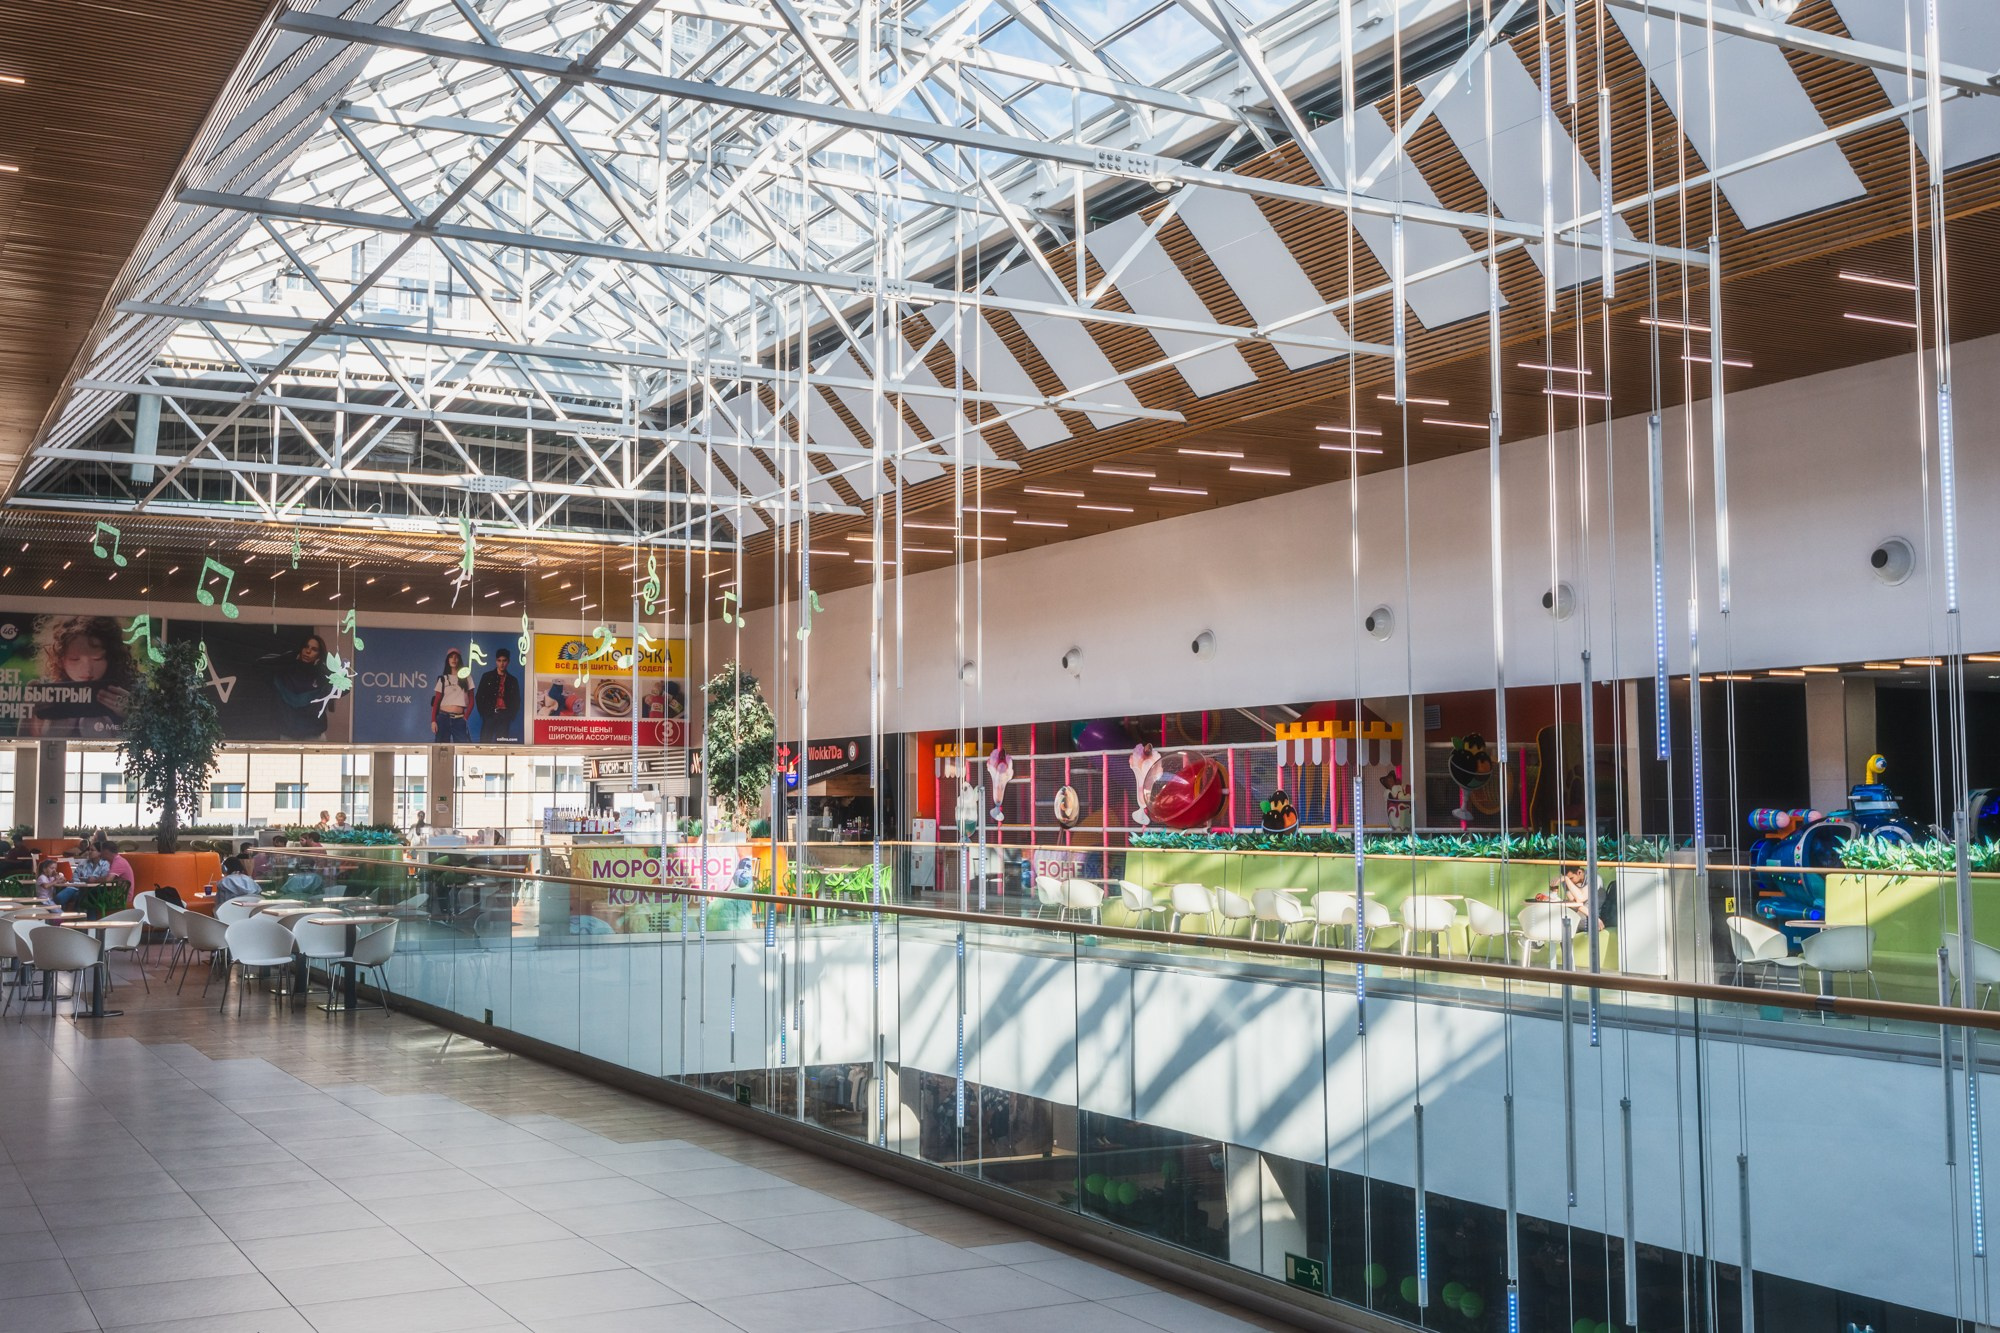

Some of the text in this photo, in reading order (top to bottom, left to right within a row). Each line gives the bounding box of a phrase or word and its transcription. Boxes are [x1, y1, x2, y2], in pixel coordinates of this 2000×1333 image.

[555, 662, 570, 670] ВСЁ
[590, 664, 618, 672] ШИТЬЯ
[628, 665, 673, 673] РКОДЕЛИЯ
[361, 671, 428, 688] COLIN'S
[24, 686, 92, 703] БЫСТРЫЙ
[376, 695, 412, 704] 2 ЭТАЖ
[548, 725, 588, 733] ПРИЯТНЫЕ
[548, 732, 584, 740] ШИРОКИЙ
[592, 858, 732, 879] МОРОЖЕНОЕ
